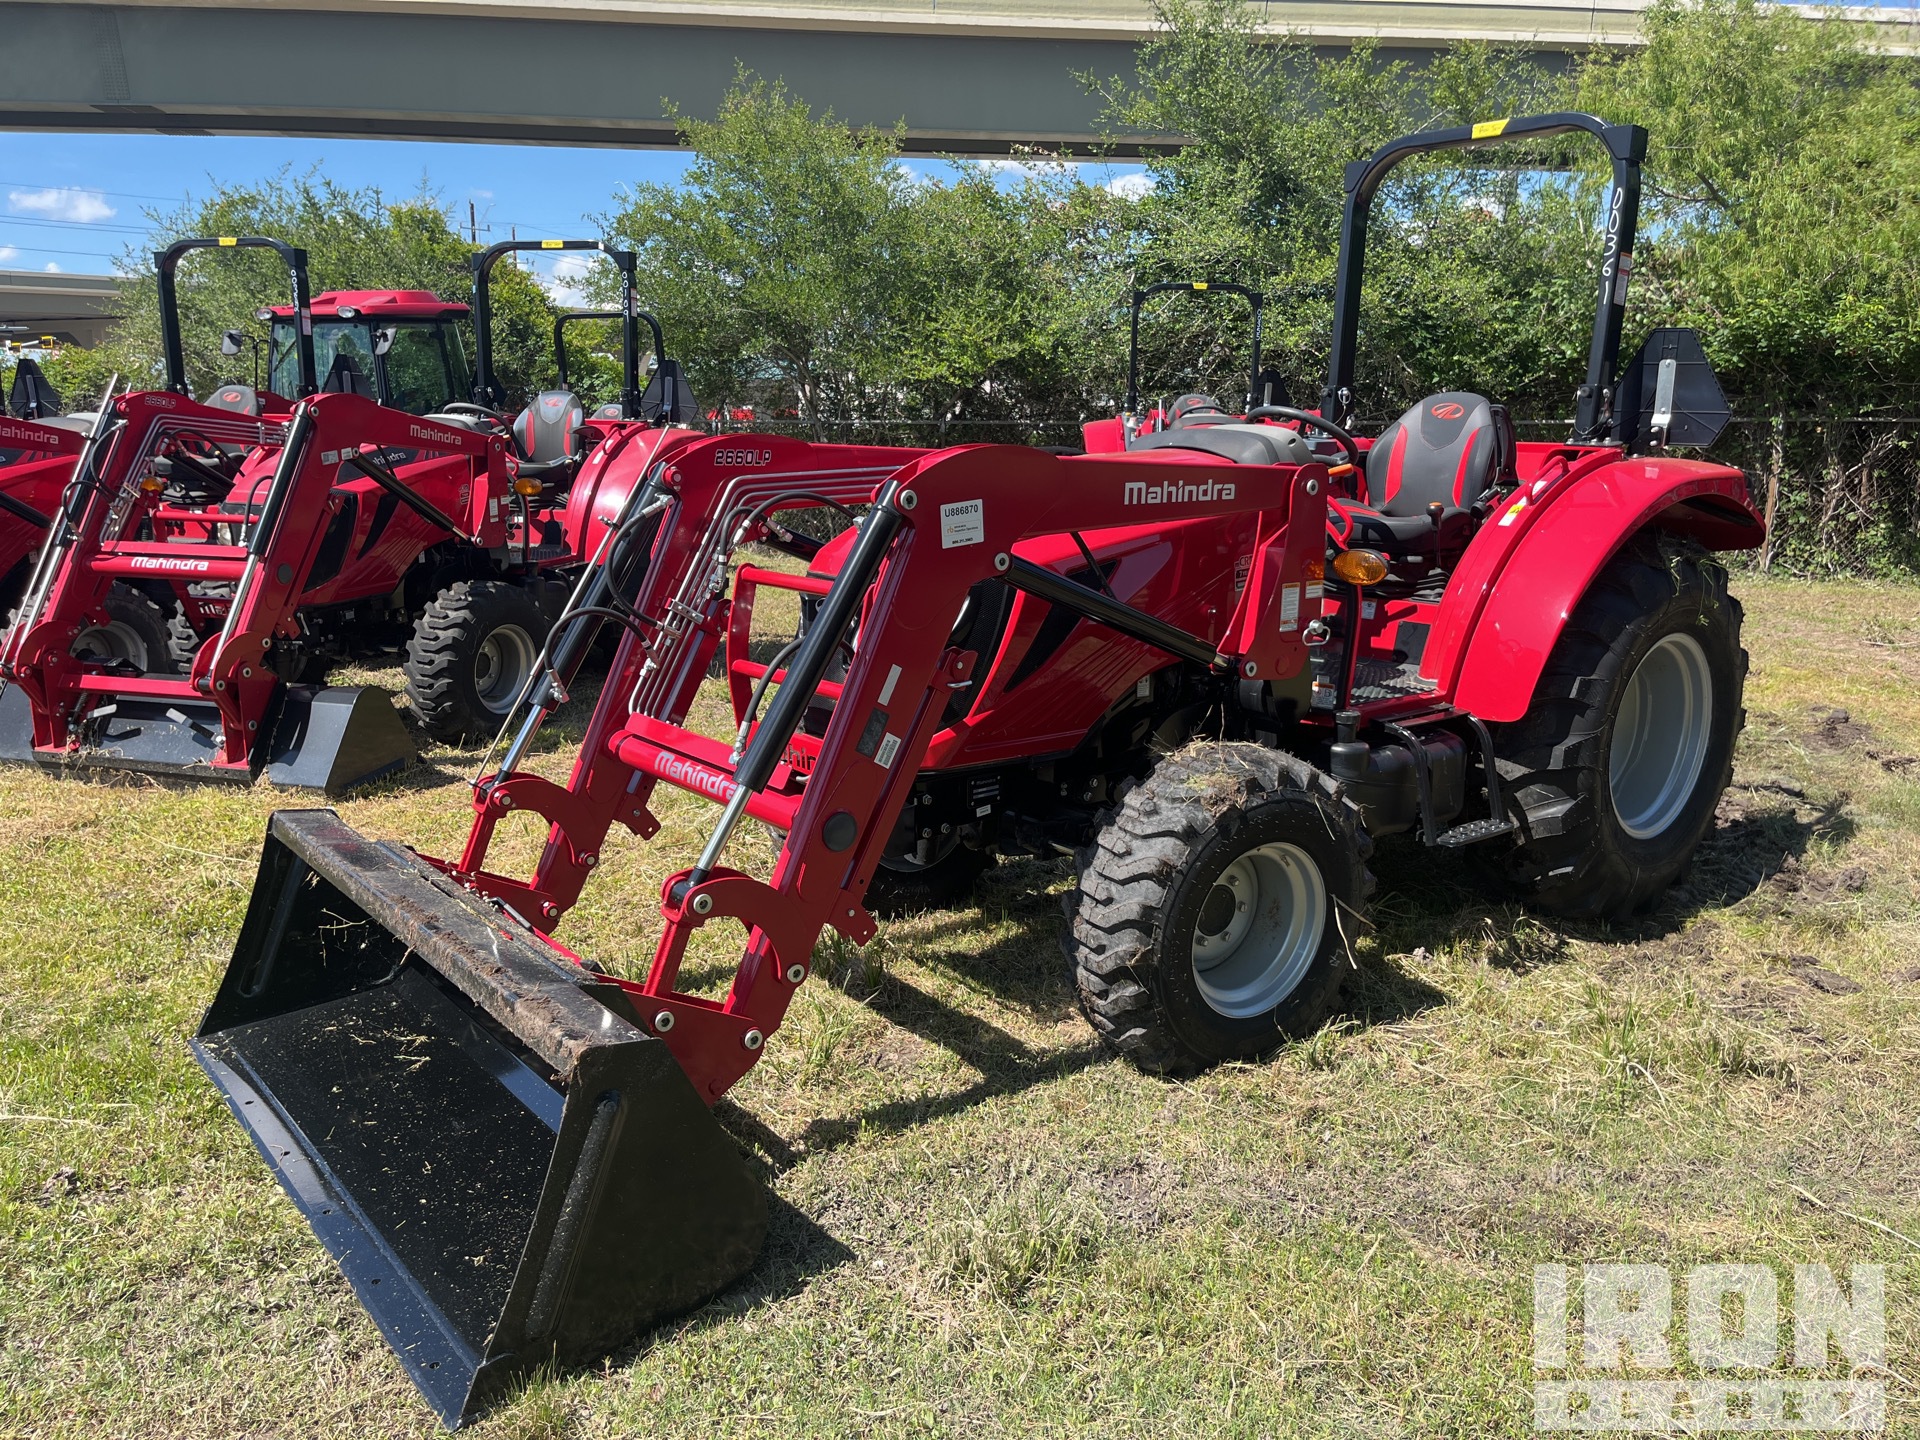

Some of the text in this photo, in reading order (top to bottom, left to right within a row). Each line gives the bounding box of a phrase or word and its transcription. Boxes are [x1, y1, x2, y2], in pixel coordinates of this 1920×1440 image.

[1601, 186, 1623, 305] 00361
[410, 424, 462, 445] Mahindra
[714, 449, 772, 467] 2660LP
[1123, 478, 1236, 505] Mahindra
[944, 503, 979, 518] U886870
[130, 556, 210, 571] Mahindra
